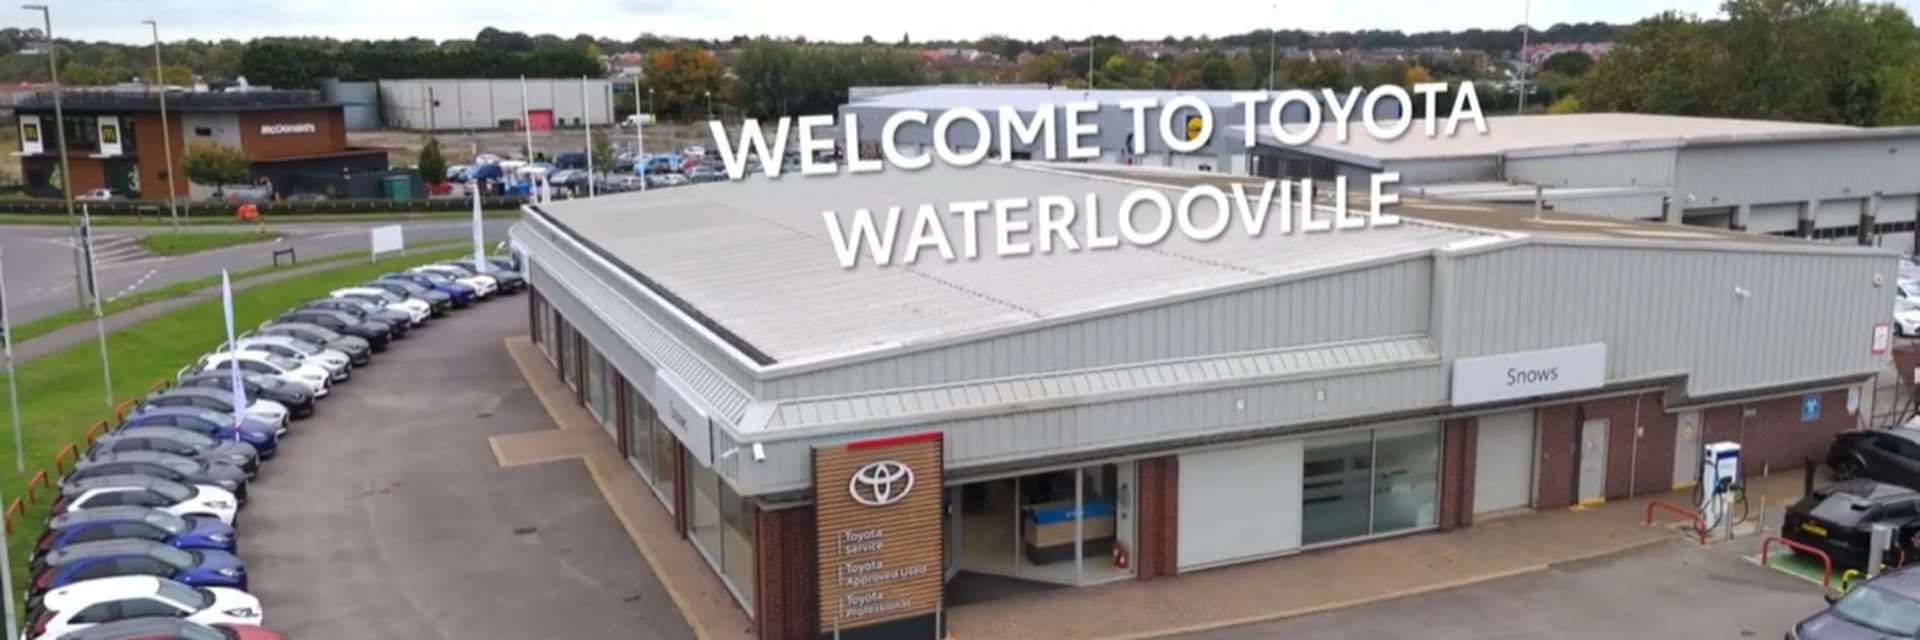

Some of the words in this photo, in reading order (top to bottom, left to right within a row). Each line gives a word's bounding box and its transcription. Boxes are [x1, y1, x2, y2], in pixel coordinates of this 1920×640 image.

[1506, 367, 1559, 386] Snows
[846, 529, 882, 541] Toyota
[846, 561, 882, 574] Toyota
[846, 592, 883, 605] Toyota
